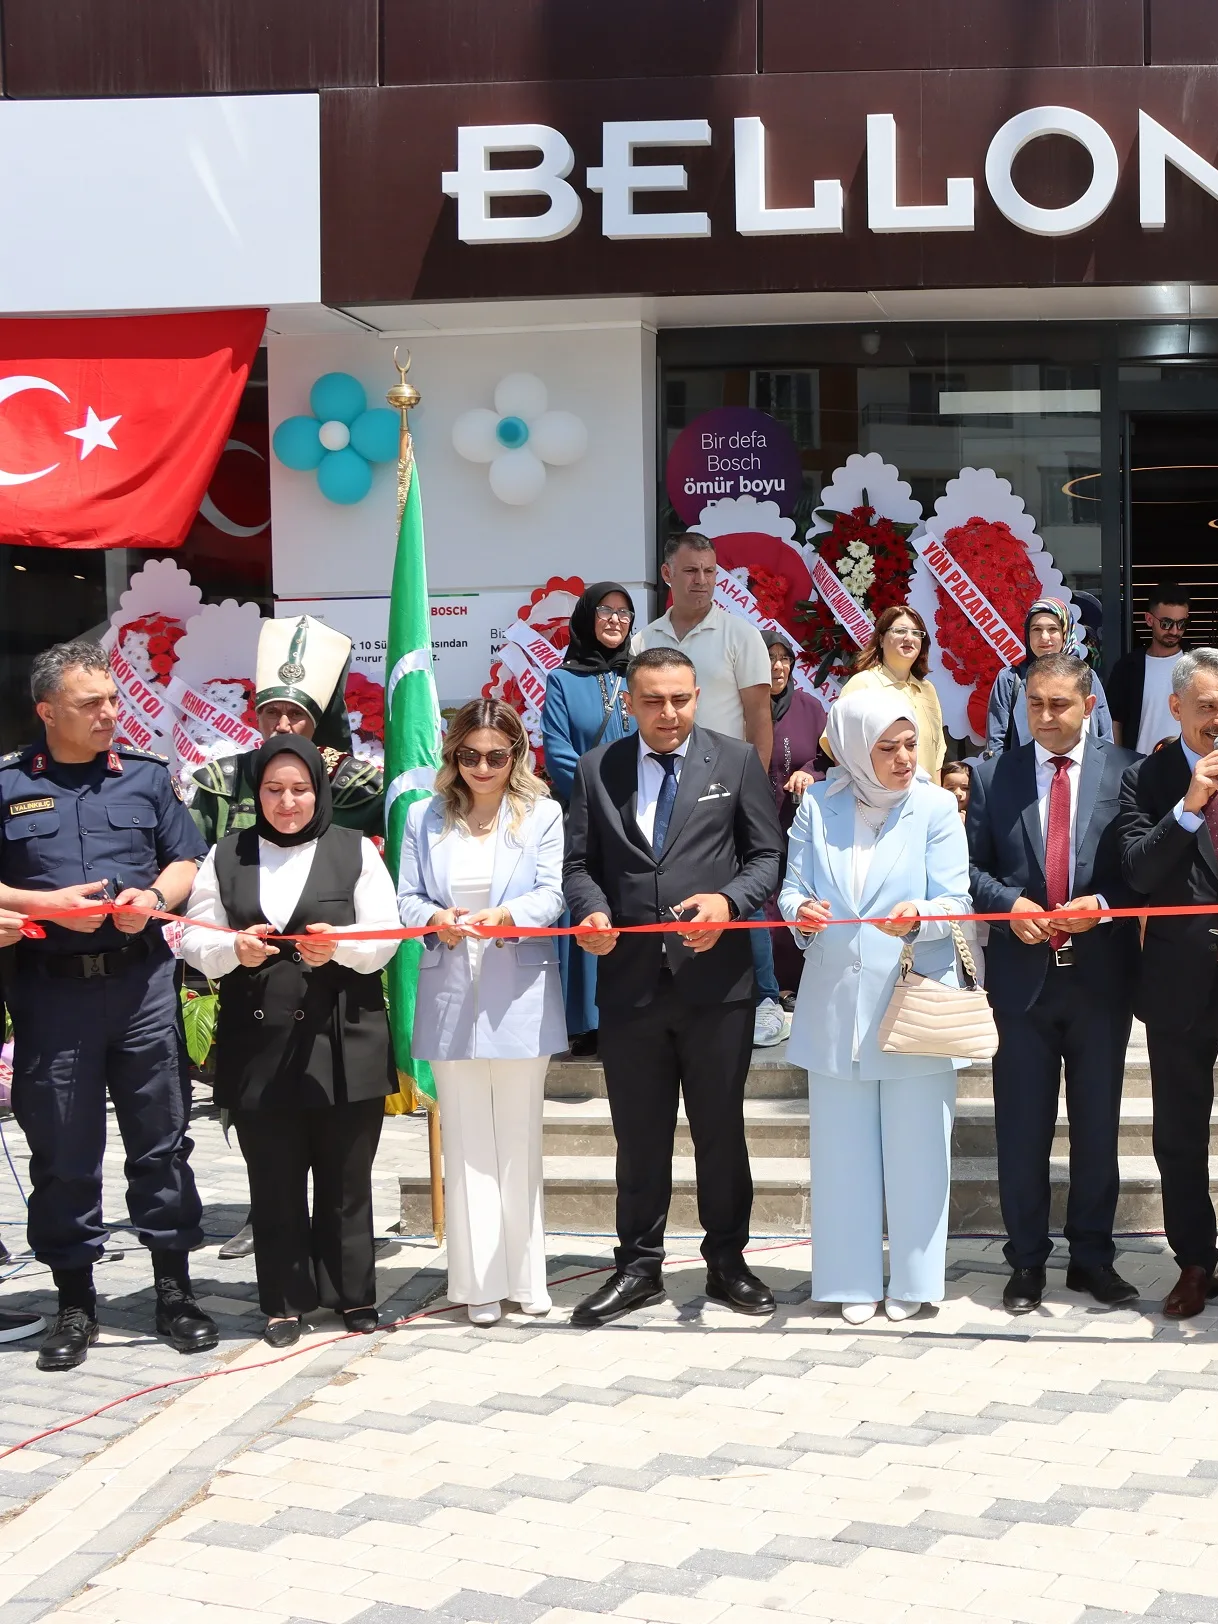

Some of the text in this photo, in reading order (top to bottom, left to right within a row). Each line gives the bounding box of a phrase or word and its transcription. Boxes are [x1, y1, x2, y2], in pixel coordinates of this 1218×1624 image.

[701, 430, 768, 450] Bir defa
[707, 453, 761, 472] Bosch
[684, 475, 786, 496] ömür boyu
[922, 541, 953, 576] YÖN
[821, 575, 842, 600] KUZEY
[430, 605, 468, 617] BOSCH
[830, 591, 862, 625] ANADOLU
[359, 640, 372, 650] 10
[181, 690, 254, 746] MEHMET-ADEM
[123, 712, 152, 748] ÖMER
